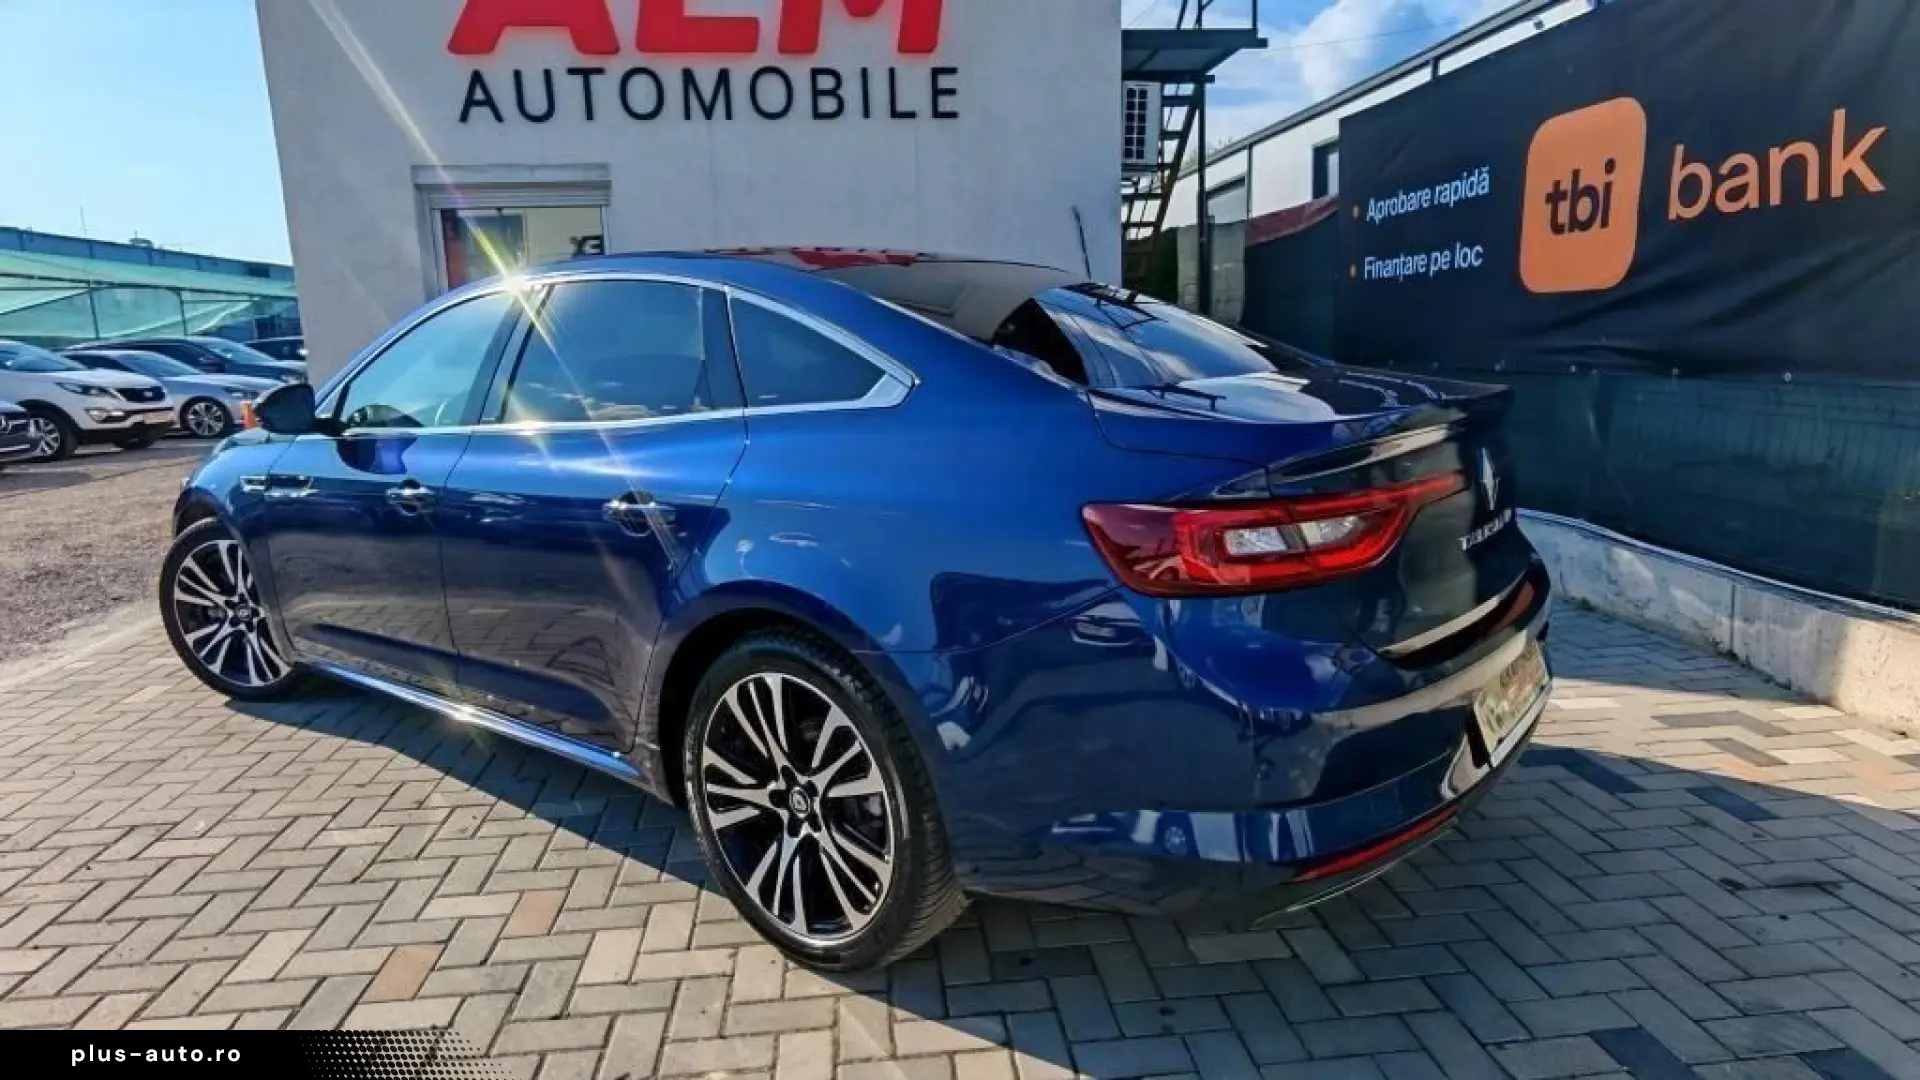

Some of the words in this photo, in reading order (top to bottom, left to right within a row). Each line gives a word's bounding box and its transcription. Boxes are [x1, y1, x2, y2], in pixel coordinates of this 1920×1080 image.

[458, 66, 959, 124] AUTOMOBILE
[1366, 188, 1432, 225] Aprobare
[1434, 165, 1490, 208] rapidă
[1545, 158, 1616, 235] tbi
[1668, 108, 1888, 220] bank
[1429, 250, 1452, 278] pe
[1454, 241, 1484, 269] loc
